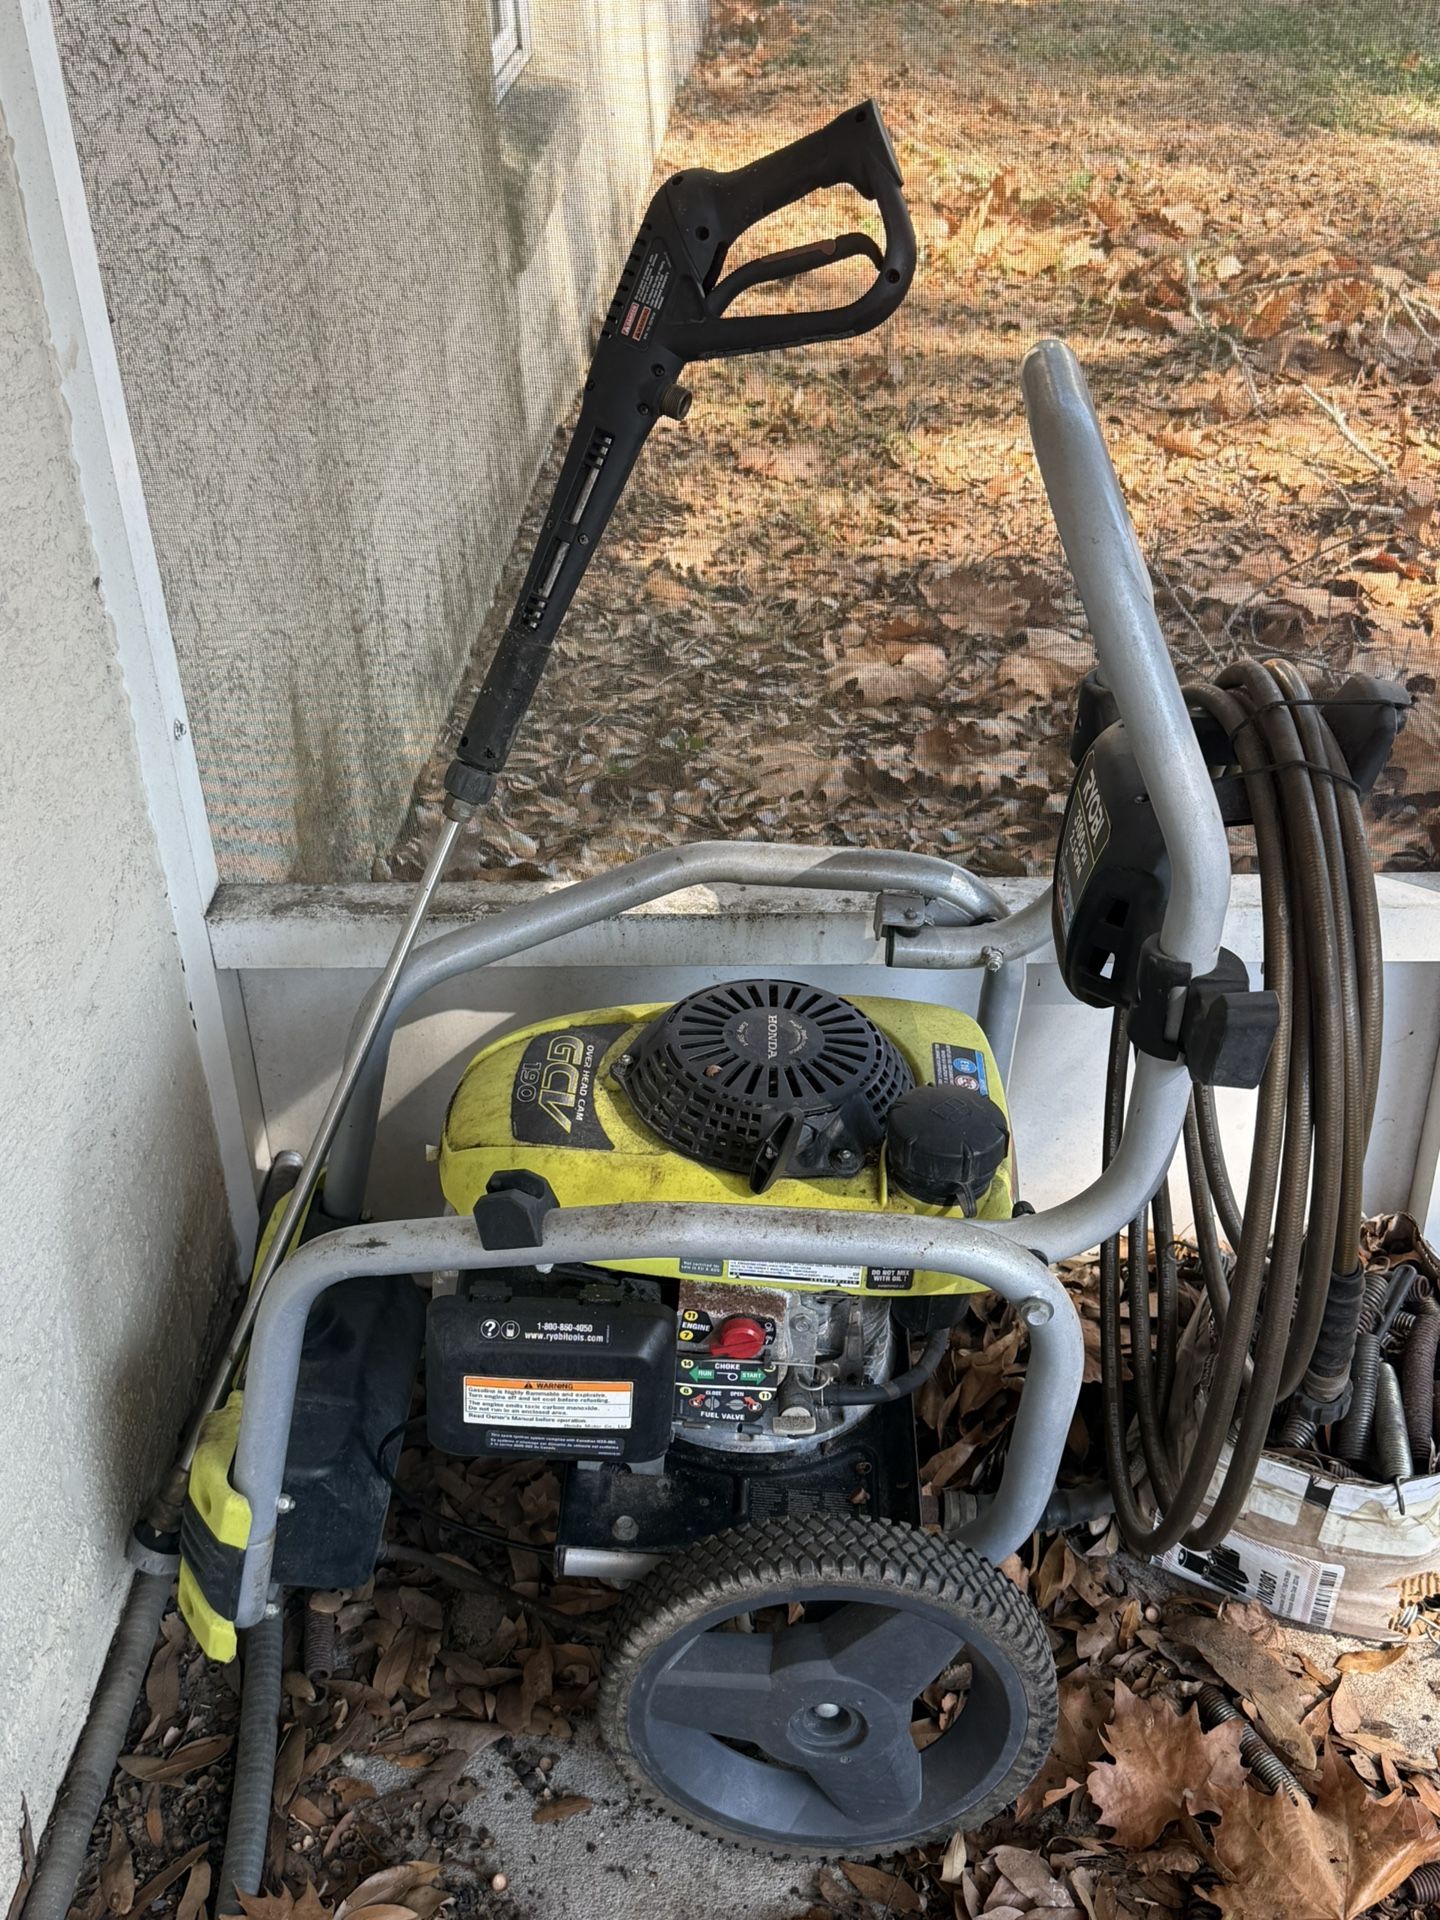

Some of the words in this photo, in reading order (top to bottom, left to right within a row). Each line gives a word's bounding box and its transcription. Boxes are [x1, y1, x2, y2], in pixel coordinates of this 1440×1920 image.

[1083, 768, 1105, 847] RYOBI
[767, 1014, 778, 1060] HONDA
[583, 1044, 595, 1068] OVER
[516, 1062, 542, 1102] 190
[538, 1035, 585, 1135] GCV
[579, 1069, 591, 1096] HEAD
[575, 1099, 586, 1121] CAM
[524, 1332, 604, 1342] www.ryobitools.com
[537, 1321, 593, 1333] 1-800-860-4050
[682, 1322, 711, 1332] ENGINE
[698, 1369, 712, 1377] RUN
[714, 1362, 740, 1370] CHOKE
[537, 1383, 573, 1391] WARNING
[1255, 1569, 1279, 1606] UN3091
